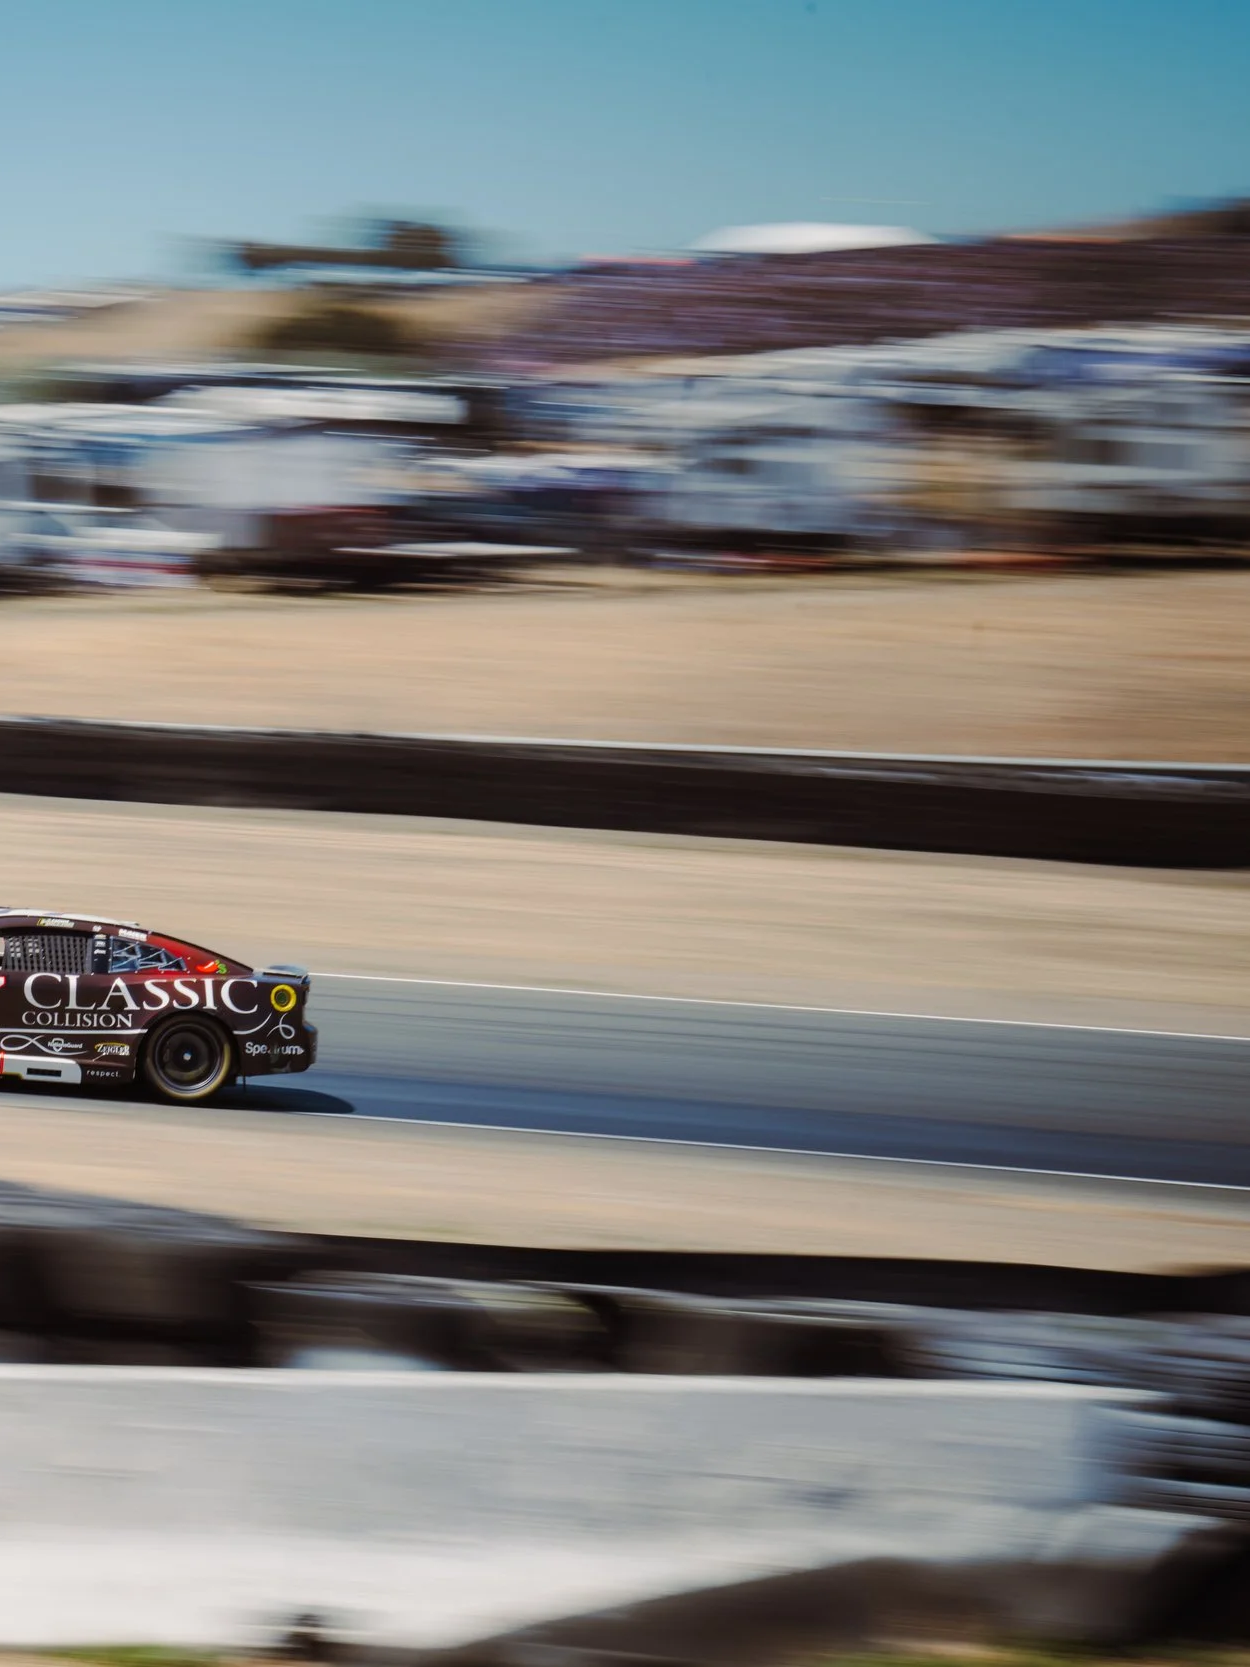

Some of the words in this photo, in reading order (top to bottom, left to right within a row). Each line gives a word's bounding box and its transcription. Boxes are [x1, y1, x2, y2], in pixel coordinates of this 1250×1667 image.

[23, 972, 258, 1014] CLASSIC
[22, 1011, 133, 1028] COLLISION
[245, 1041, 301, 1056] Sperum
